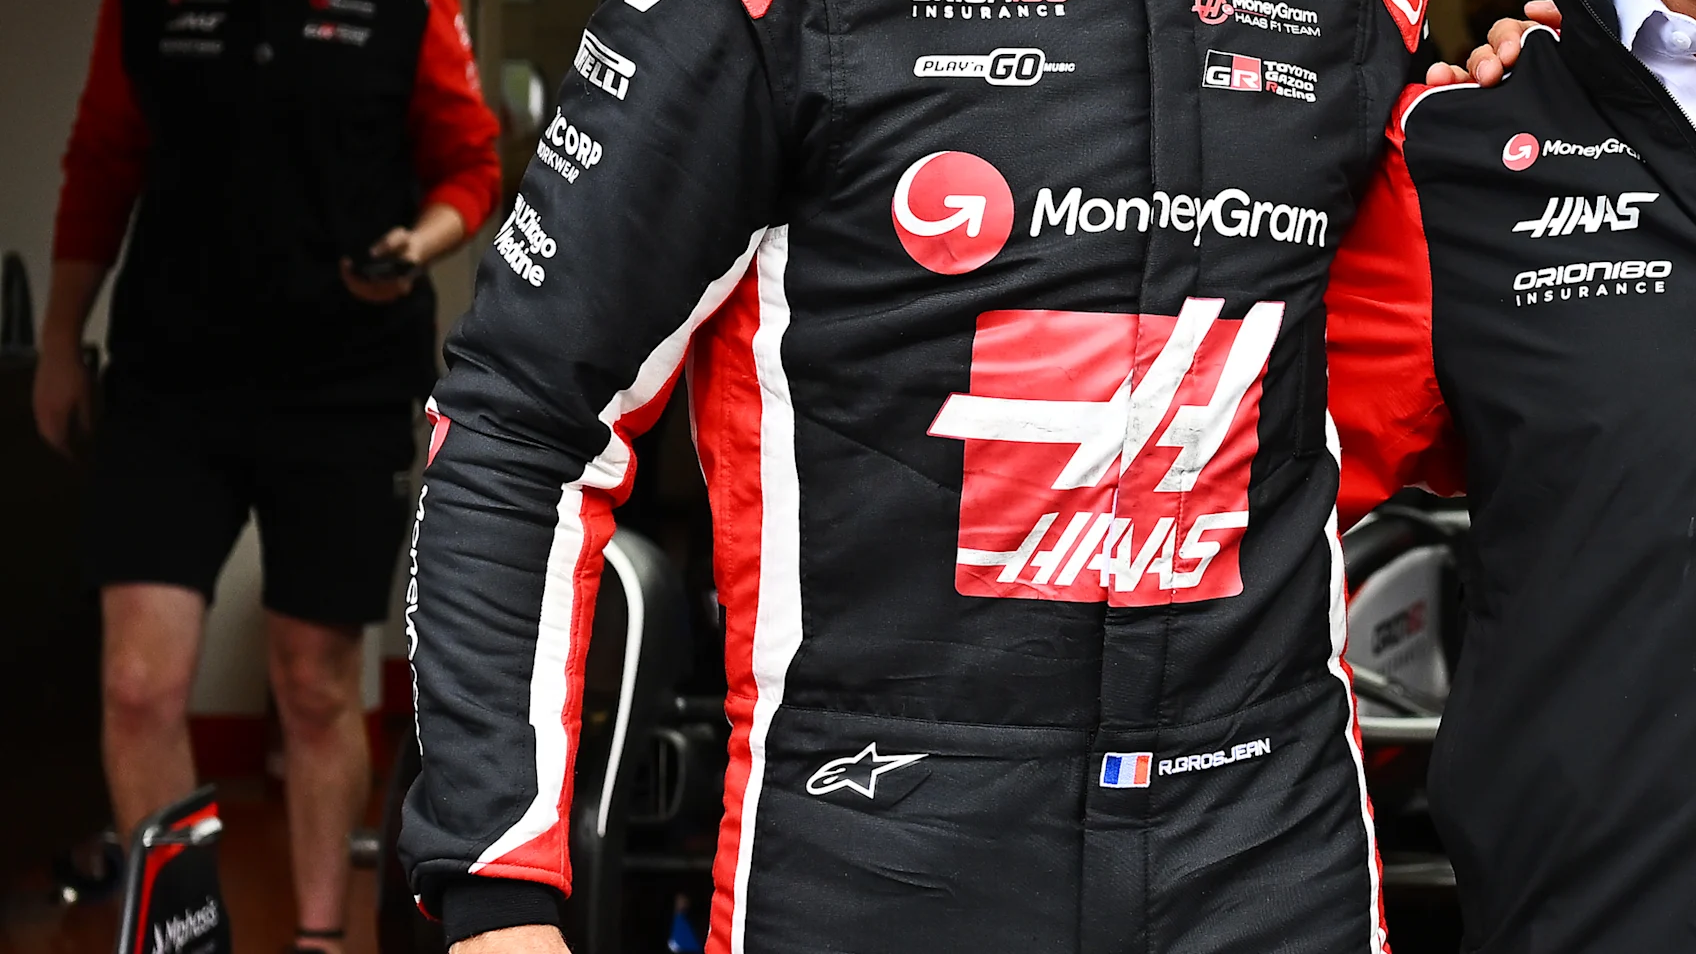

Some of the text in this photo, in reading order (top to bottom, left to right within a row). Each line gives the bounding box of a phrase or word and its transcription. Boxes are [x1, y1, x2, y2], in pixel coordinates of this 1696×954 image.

[912, 4, 1066, 20] INSURANCE
[1235, 12, 1321, 37] HAAS F1 TEAM
[989, 53, 1041, 80] GO
[1043, 62, 1076, 73] MUSIC
[1206, 66, 1259, 88] GR
[1263, 60, 1318, 82] TOYOTA
[1265, 71, 1314, 92] GAZOO
[1265, 80, 1316, 102] Racing
[1030, 186, 1328, 246] MoneyGram
[1511, 192, 1660, 238] HAAS
[1513, 260, 1672, 291] ORION180
[1515, 281, 1665, 307] INSURANCE
[956, 510, 1249, 592] HAAS
[1159, 738, 1271, 775] R.GROSJEAN
